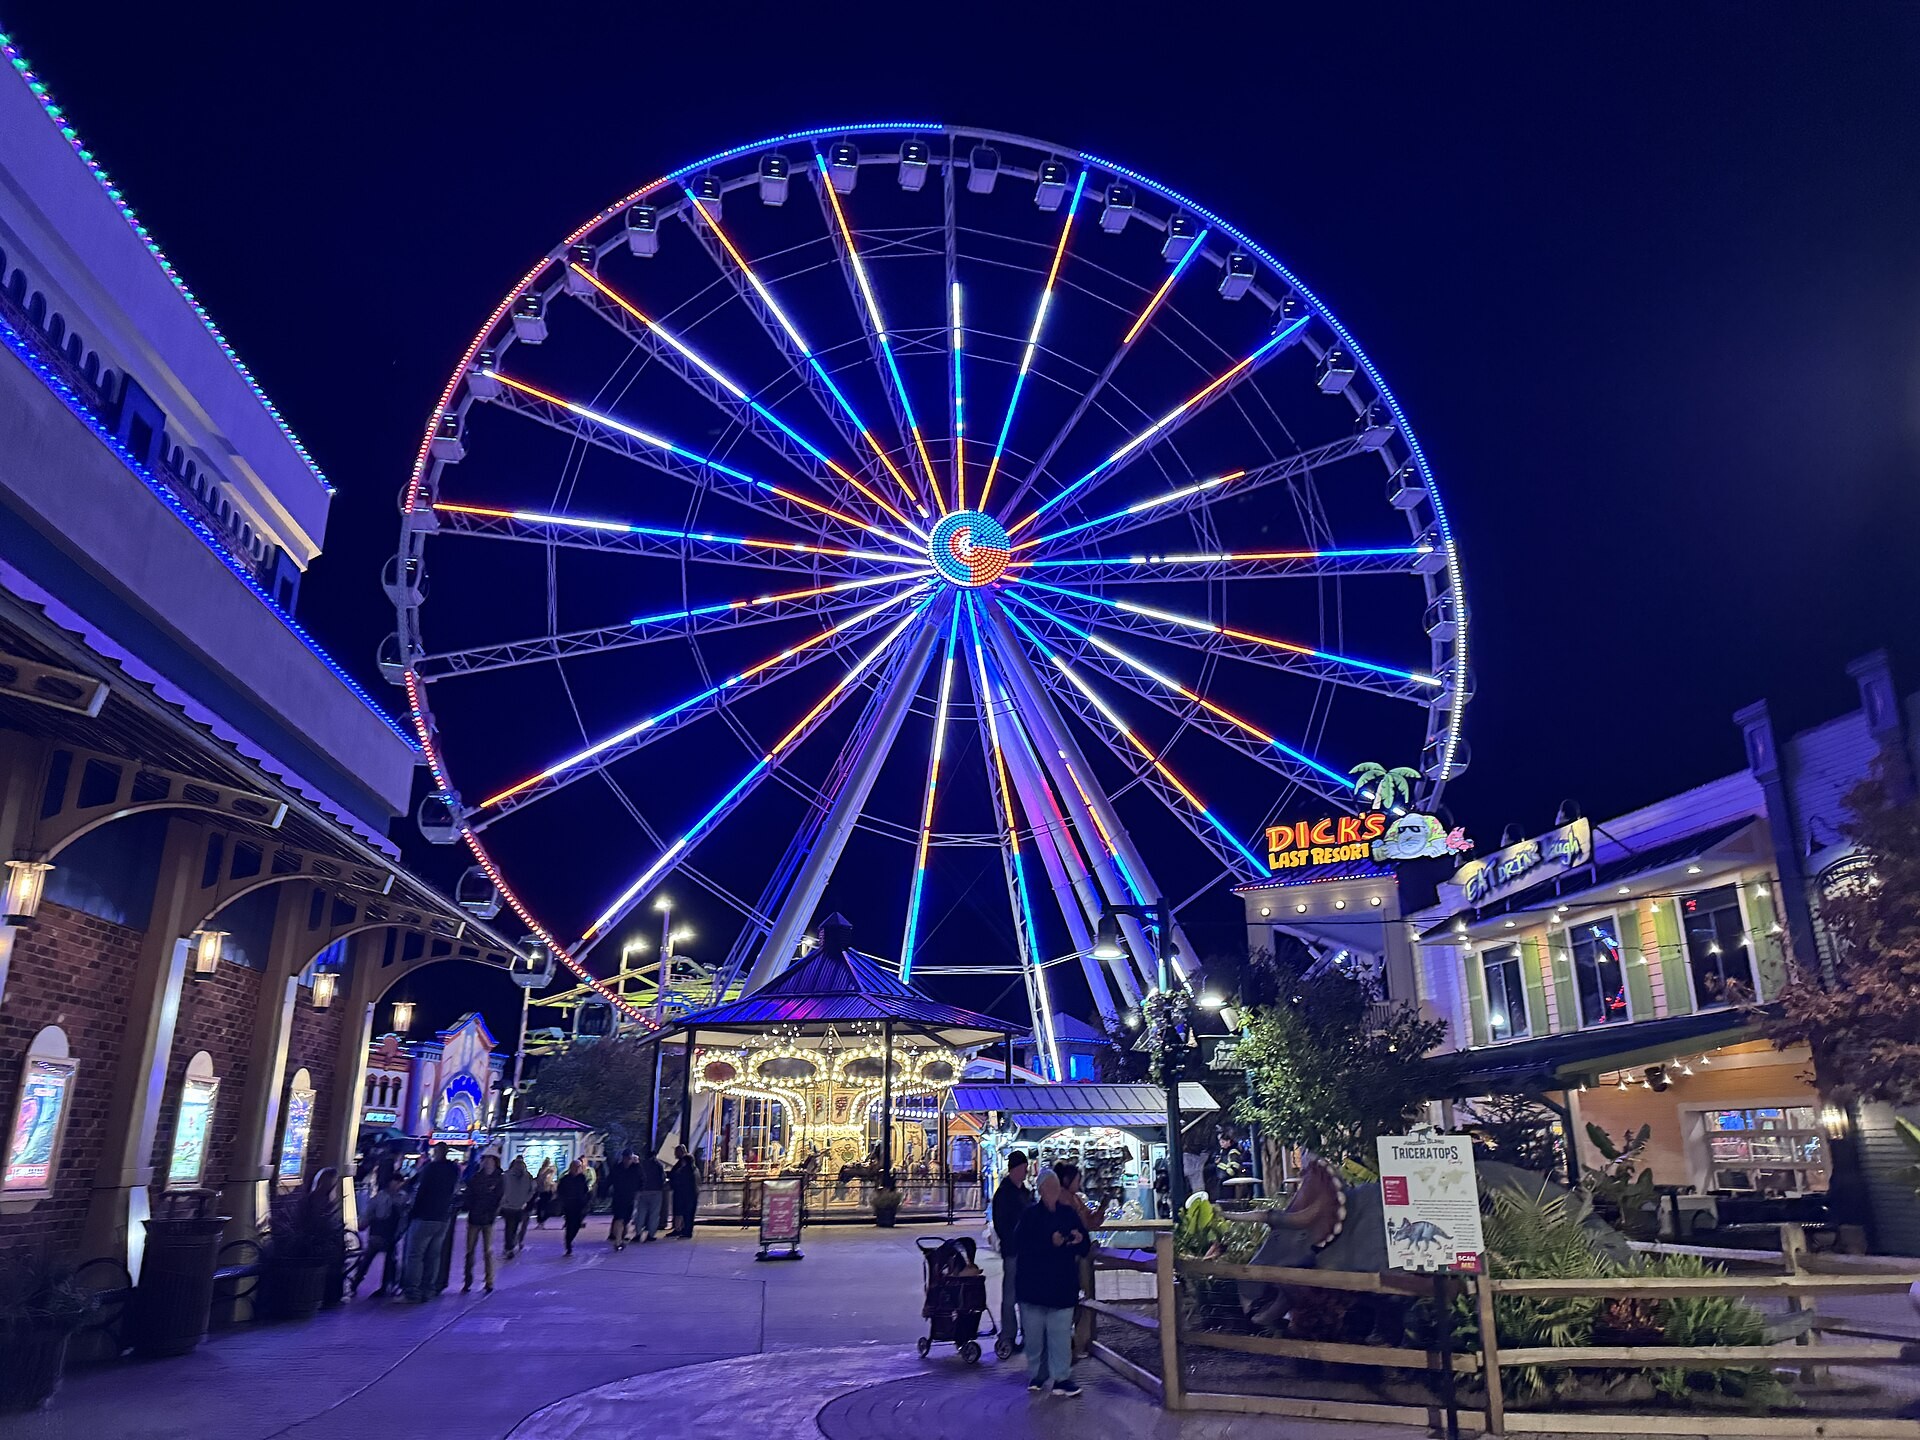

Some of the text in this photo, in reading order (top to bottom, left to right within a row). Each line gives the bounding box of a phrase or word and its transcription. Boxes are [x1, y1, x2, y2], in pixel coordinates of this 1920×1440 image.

[1265, 812, 1386, 852] DICK'S
[1268, 843, 1369, 870] LAST RESORT
[1465, 857, 1497, 902] EAT
[1391, 1145, 1458, 1160] TRICERATOPS
